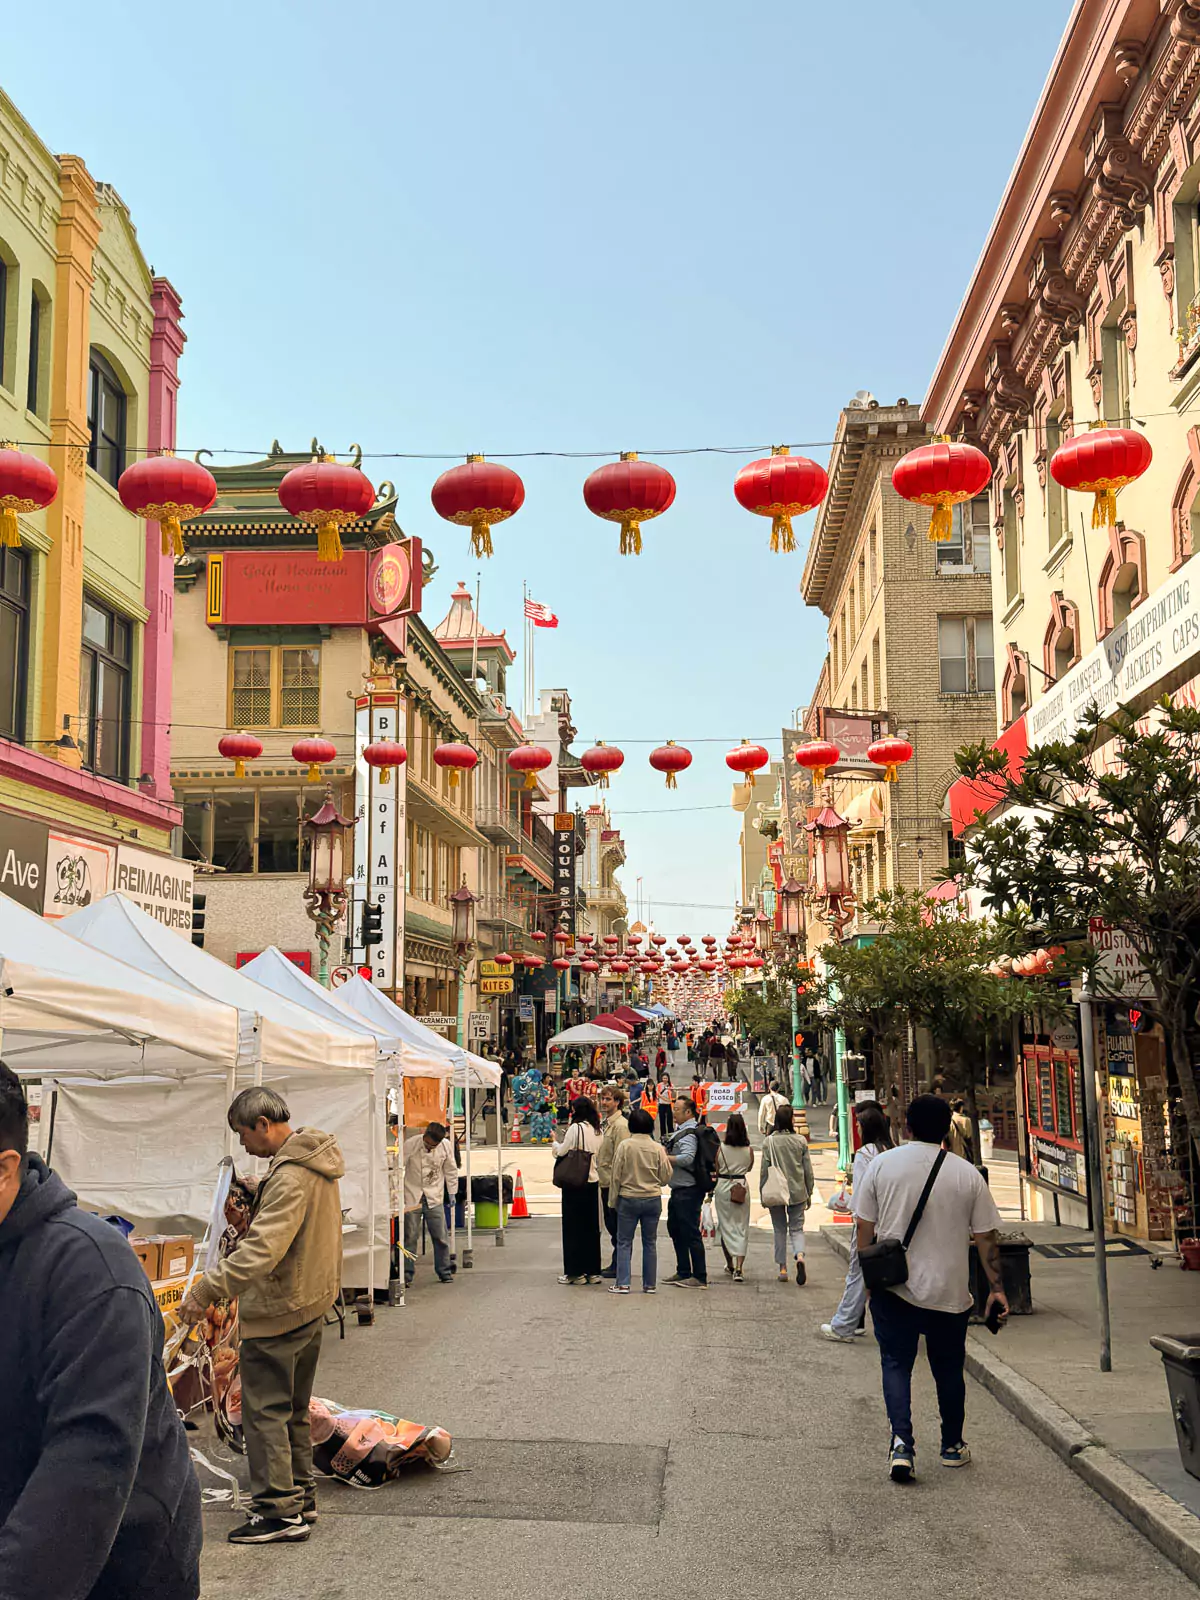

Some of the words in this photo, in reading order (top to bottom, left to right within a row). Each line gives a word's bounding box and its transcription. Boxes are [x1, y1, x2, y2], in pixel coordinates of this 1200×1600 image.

[242, 564, 277, 578] Gold
[1068, 658, 1102, 703] TRANSFER
[1114, 579, 1190, 663] SCREENPRINTING
[1125, 641, 1162, 690] JACKETS
[1172, 613, 1199, 654] CAPS
[1, 849, 39, 889] Ave
[559, 832, 571, 878] FOUR
[118, 863, 192, 904] REIMAGINE
[560, 886, 571, 932] SEAS
[483, 981, 510, 991] KITES
[416, 1016, 456, 1025] SACRAMENTO
[474, 1027, 487, 1037] 15
[1108, 1051, 1134, 1063] GoPro
[1111, 1100, 1138, 1119] SONY
